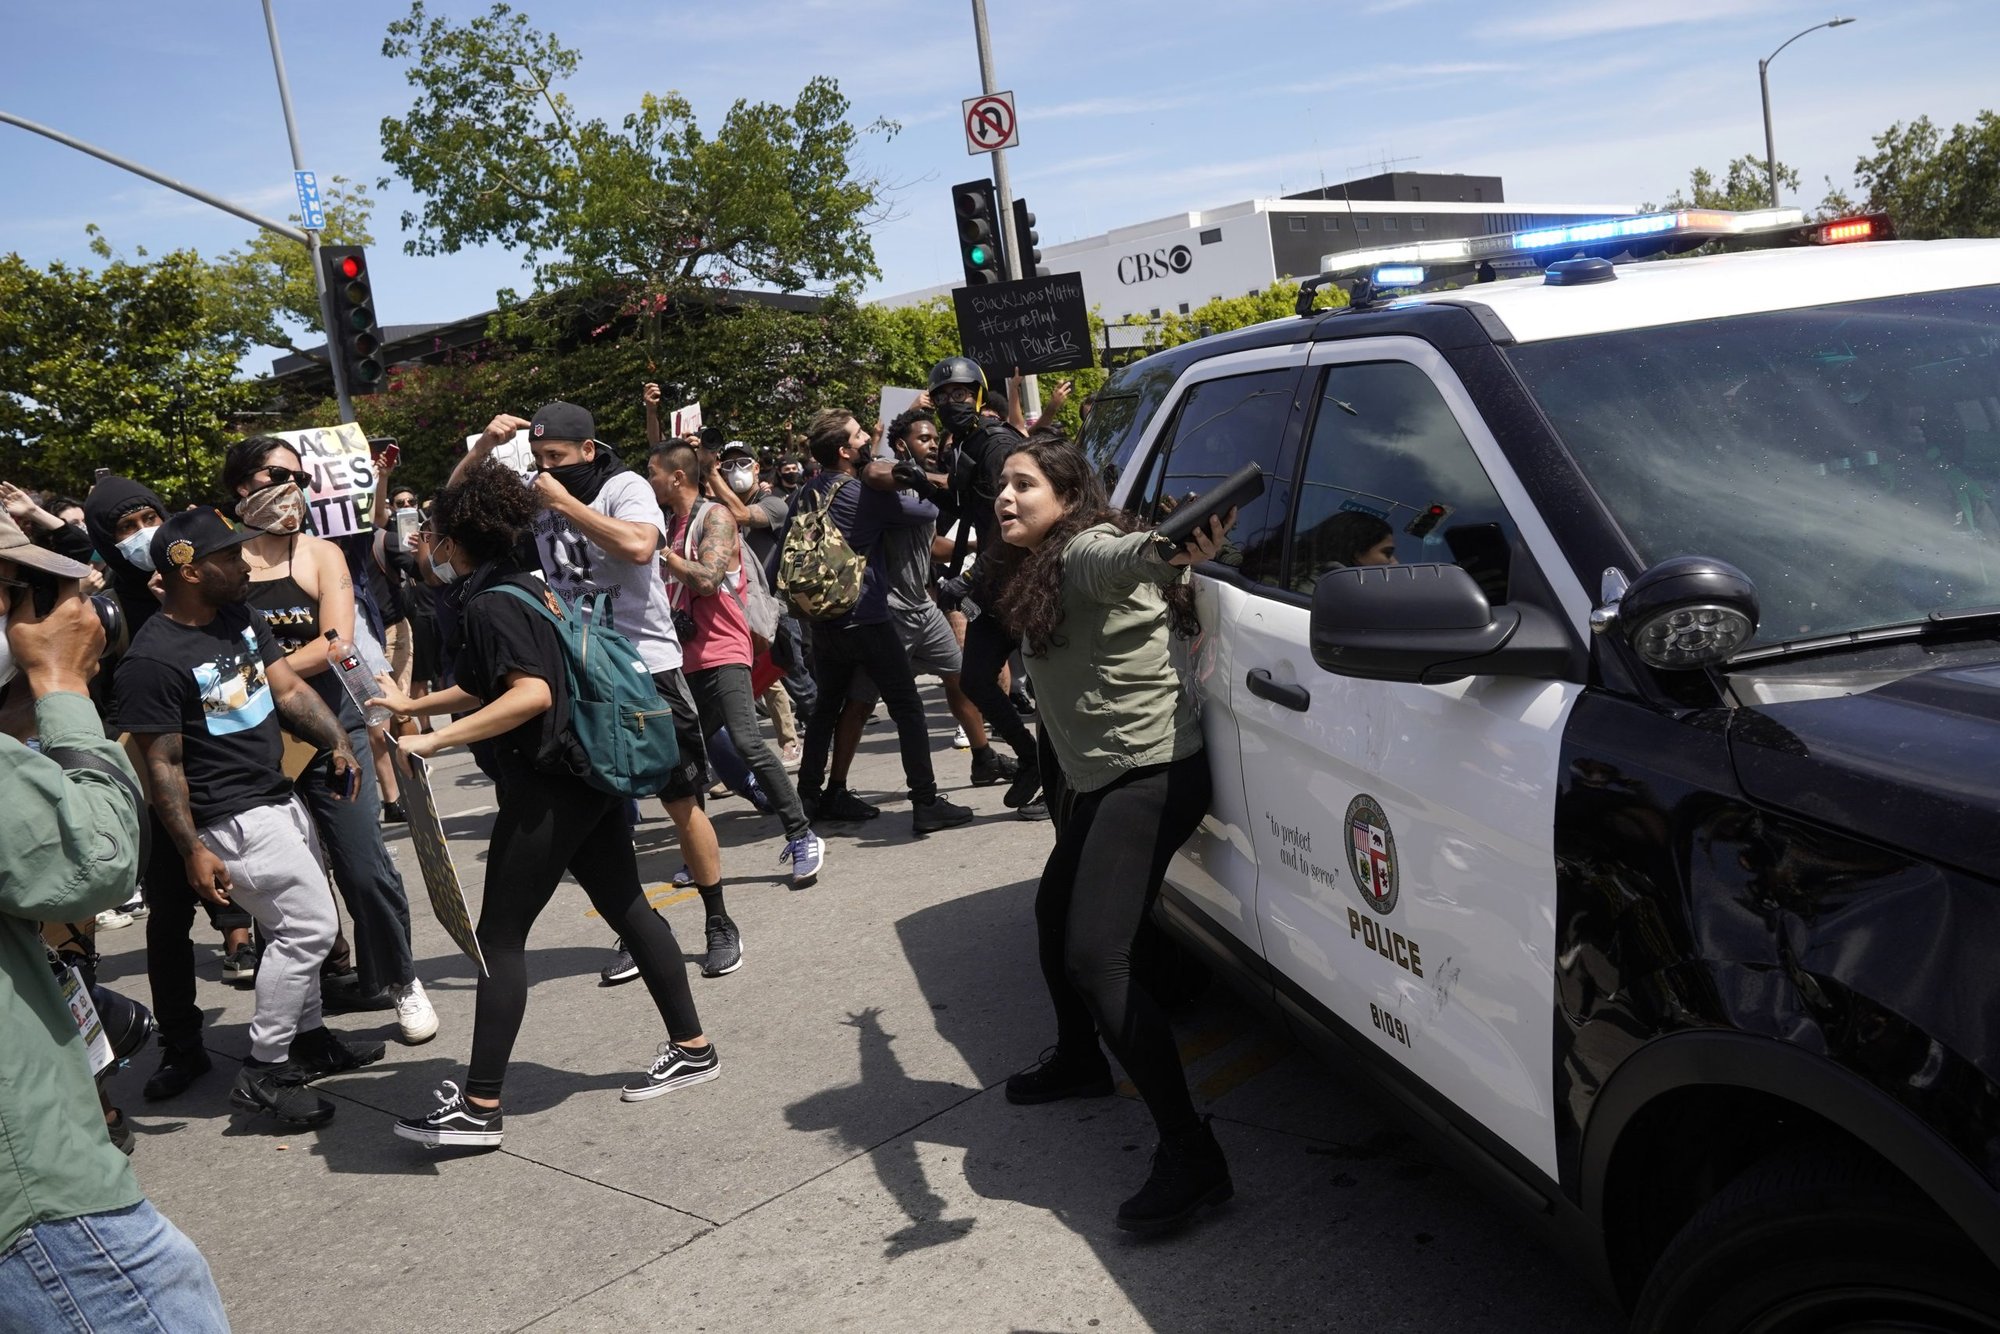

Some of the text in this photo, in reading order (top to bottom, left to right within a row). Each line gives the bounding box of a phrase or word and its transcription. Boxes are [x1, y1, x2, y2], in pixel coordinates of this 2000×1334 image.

[303, 173, 323, 225] SYNC
[1117, 248, 1169, 286] CBS
[1020, 331, 1080, 358] POWER
[299, 426, 366, 457] ACK
[309, 457, 373, 494] VES
[301, 493, 374, 537] ATTE
[1281, 825, 1311, 853] protect
[1281, 848, 1297, 871] and
[1300, 854, 1308, 876] to
[1347, 906, 1424, 979] POLICE
[1370, 1002, 1411, 1049] 81091
